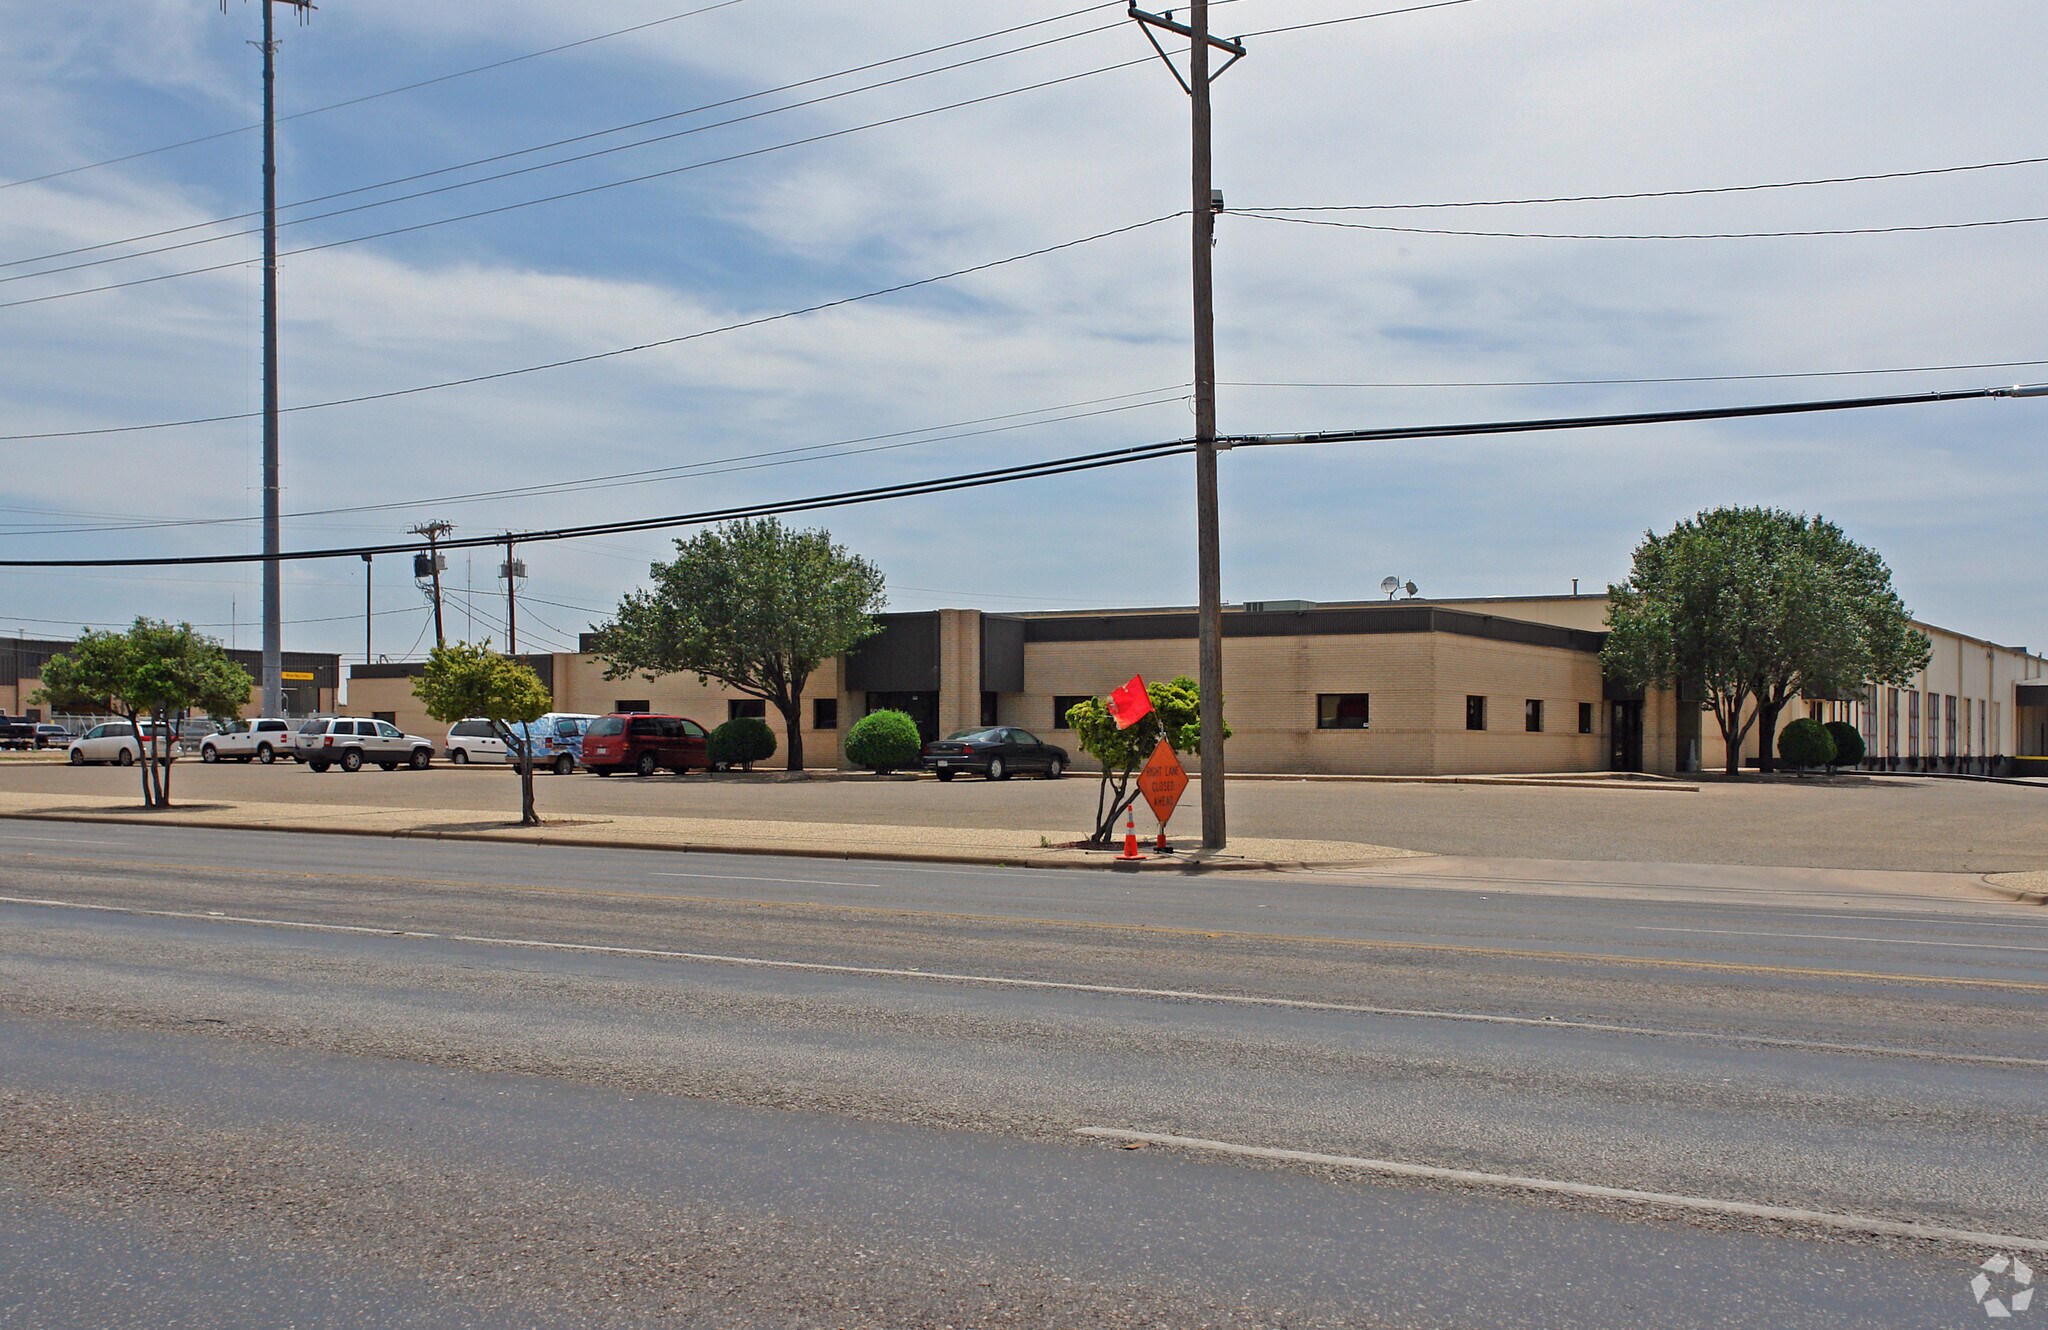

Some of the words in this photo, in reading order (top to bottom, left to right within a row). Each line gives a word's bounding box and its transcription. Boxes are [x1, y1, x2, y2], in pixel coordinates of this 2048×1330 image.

[1146, 766, 1162, 777] RIGHT
[1165, 766, 1179, 776] LANE
[1152, 781, 1174, 792] CLOSED
[1154, 795, 1174, 806] AHEAD
